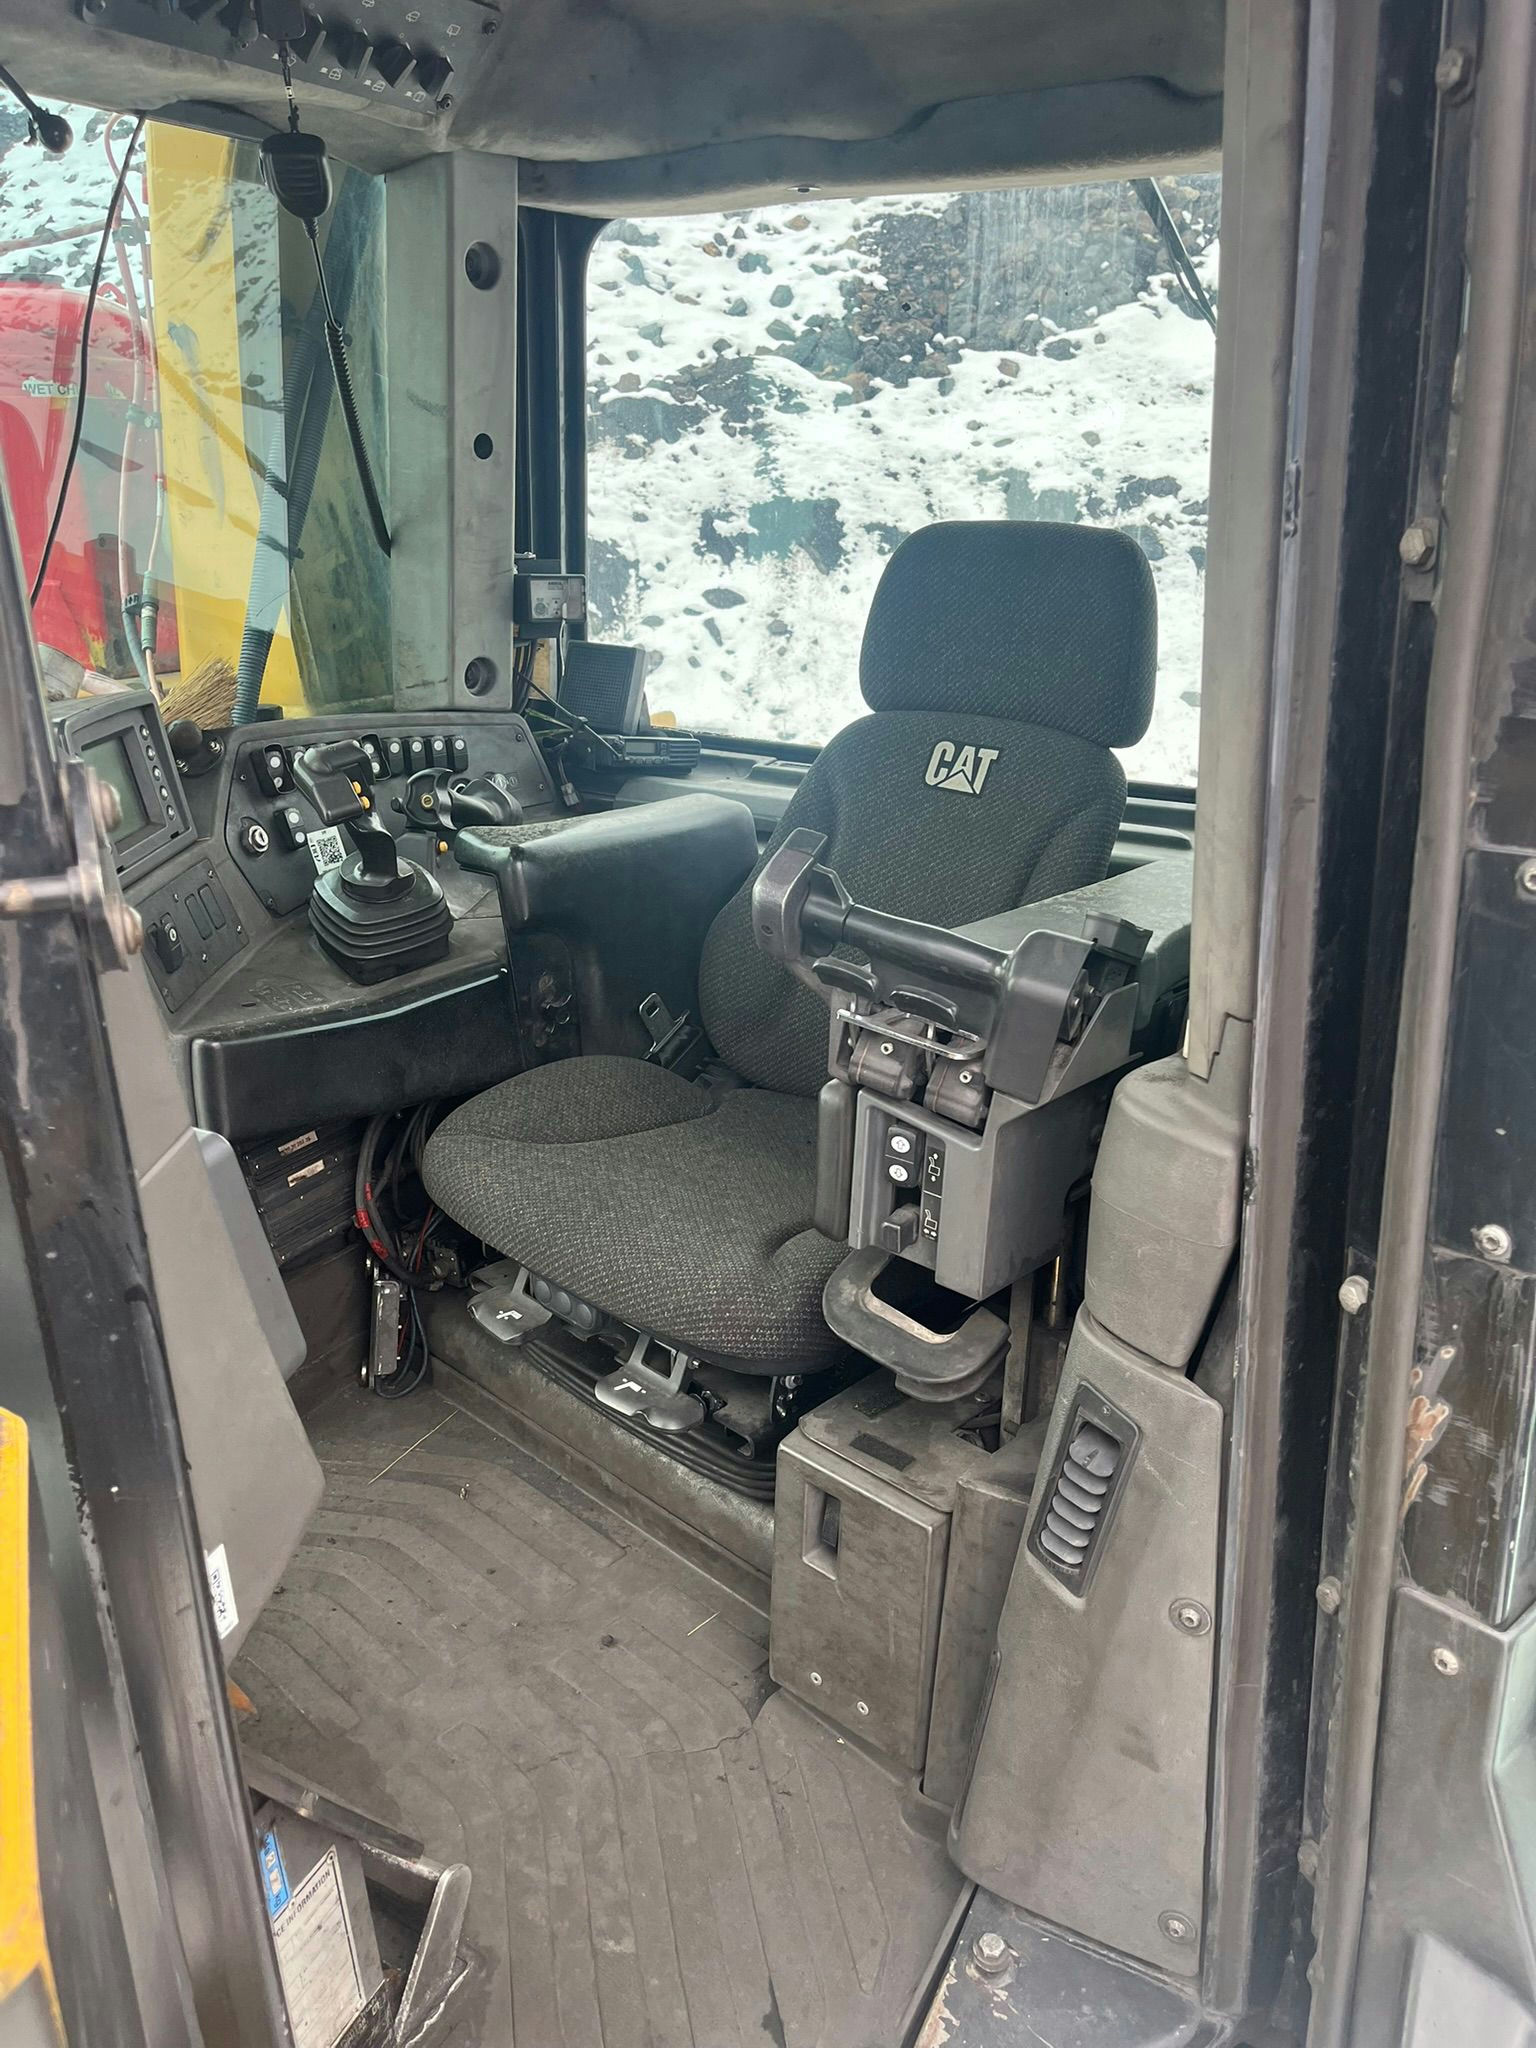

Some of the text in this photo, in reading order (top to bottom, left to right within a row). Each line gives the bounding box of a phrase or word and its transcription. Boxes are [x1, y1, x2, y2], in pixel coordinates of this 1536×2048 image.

[23, 383, 53, 395] WET
[925, 741, 999, 794] CAT
[286, 1867, 331, 1926] INFORMATION
